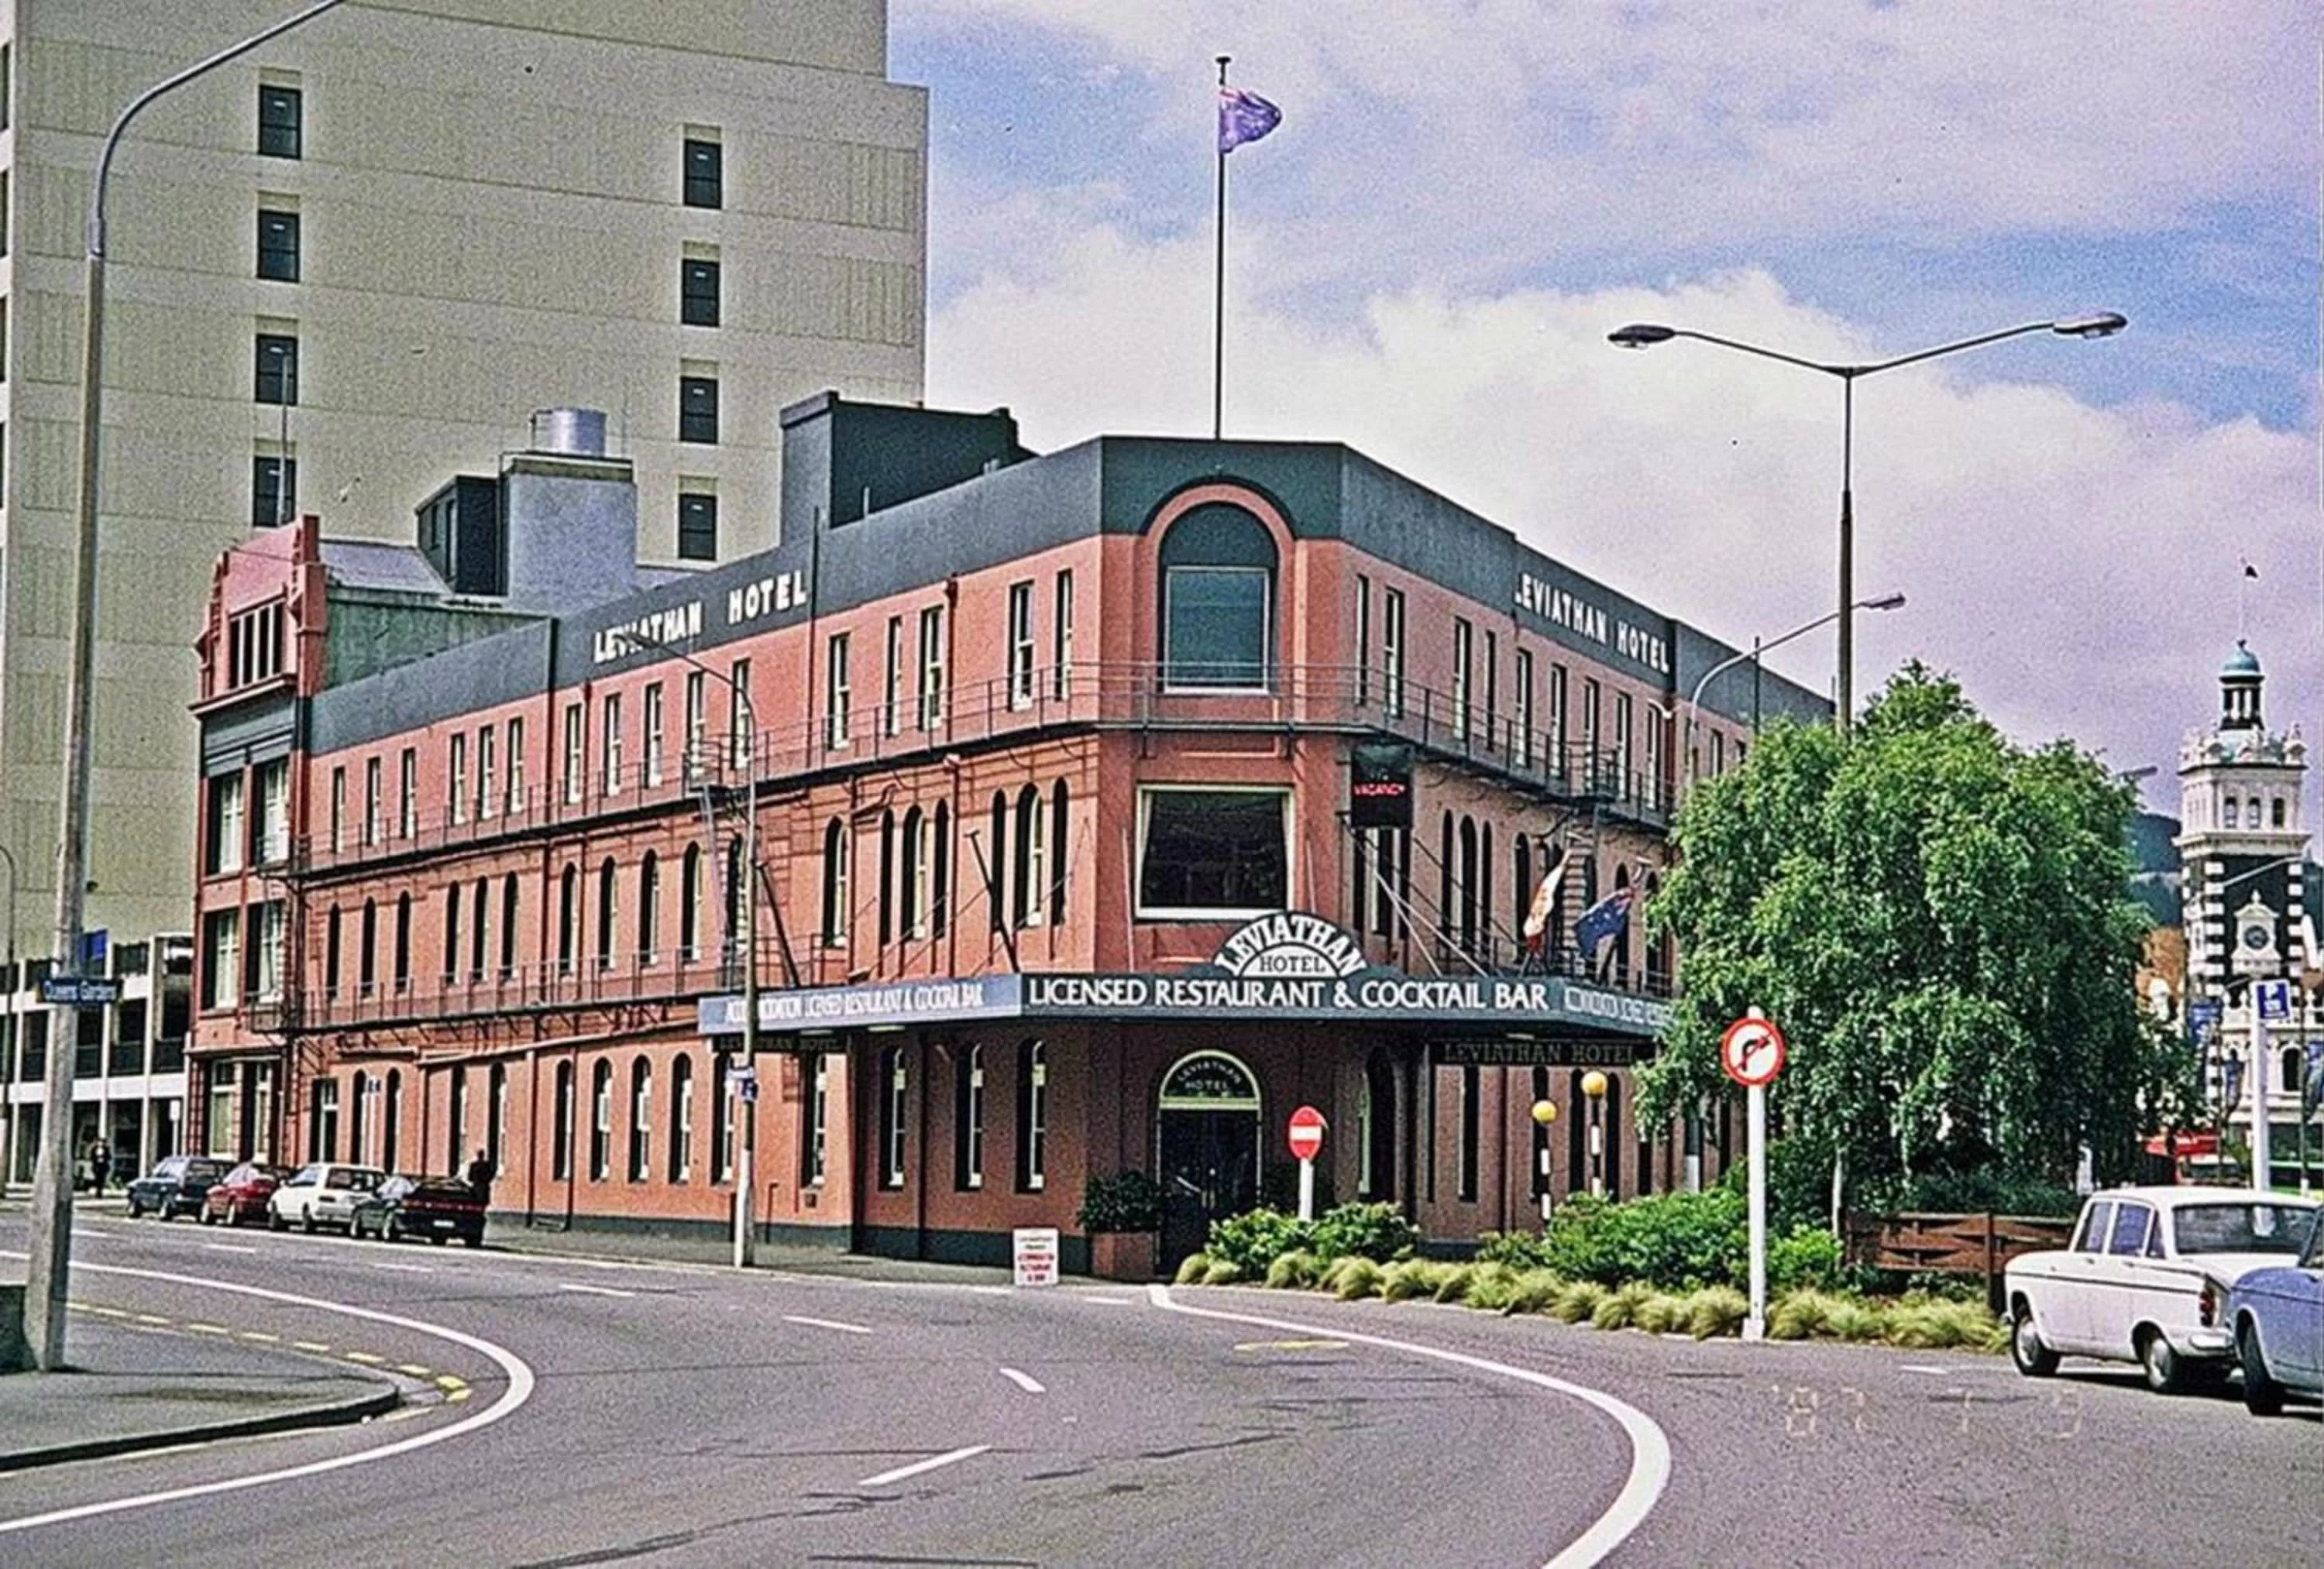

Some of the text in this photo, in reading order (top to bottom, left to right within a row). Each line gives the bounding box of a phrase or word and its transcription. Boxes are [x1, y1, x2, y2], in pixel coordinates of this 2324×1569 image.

[593, 570, 807, 664] LEVIATHAN HOTEL
[1617, 620, 1669, 675] HOTEL
[1214, 914, 1367, 977] LEVIATHAN
[1260, 955, 1327, 973] HOTEL
[1029, 979, 1147, 1006] LICENSED
[1155, 981, 1329, 1007] RESTAURANT
[1332, 984, 1356, 1008] &
[1360, 981, 1486, 1008] COCKTAIL
[1495, 983, 1549, 1010] BAR
[1177, 1061, 1242, 1083] LEVIATHAN
